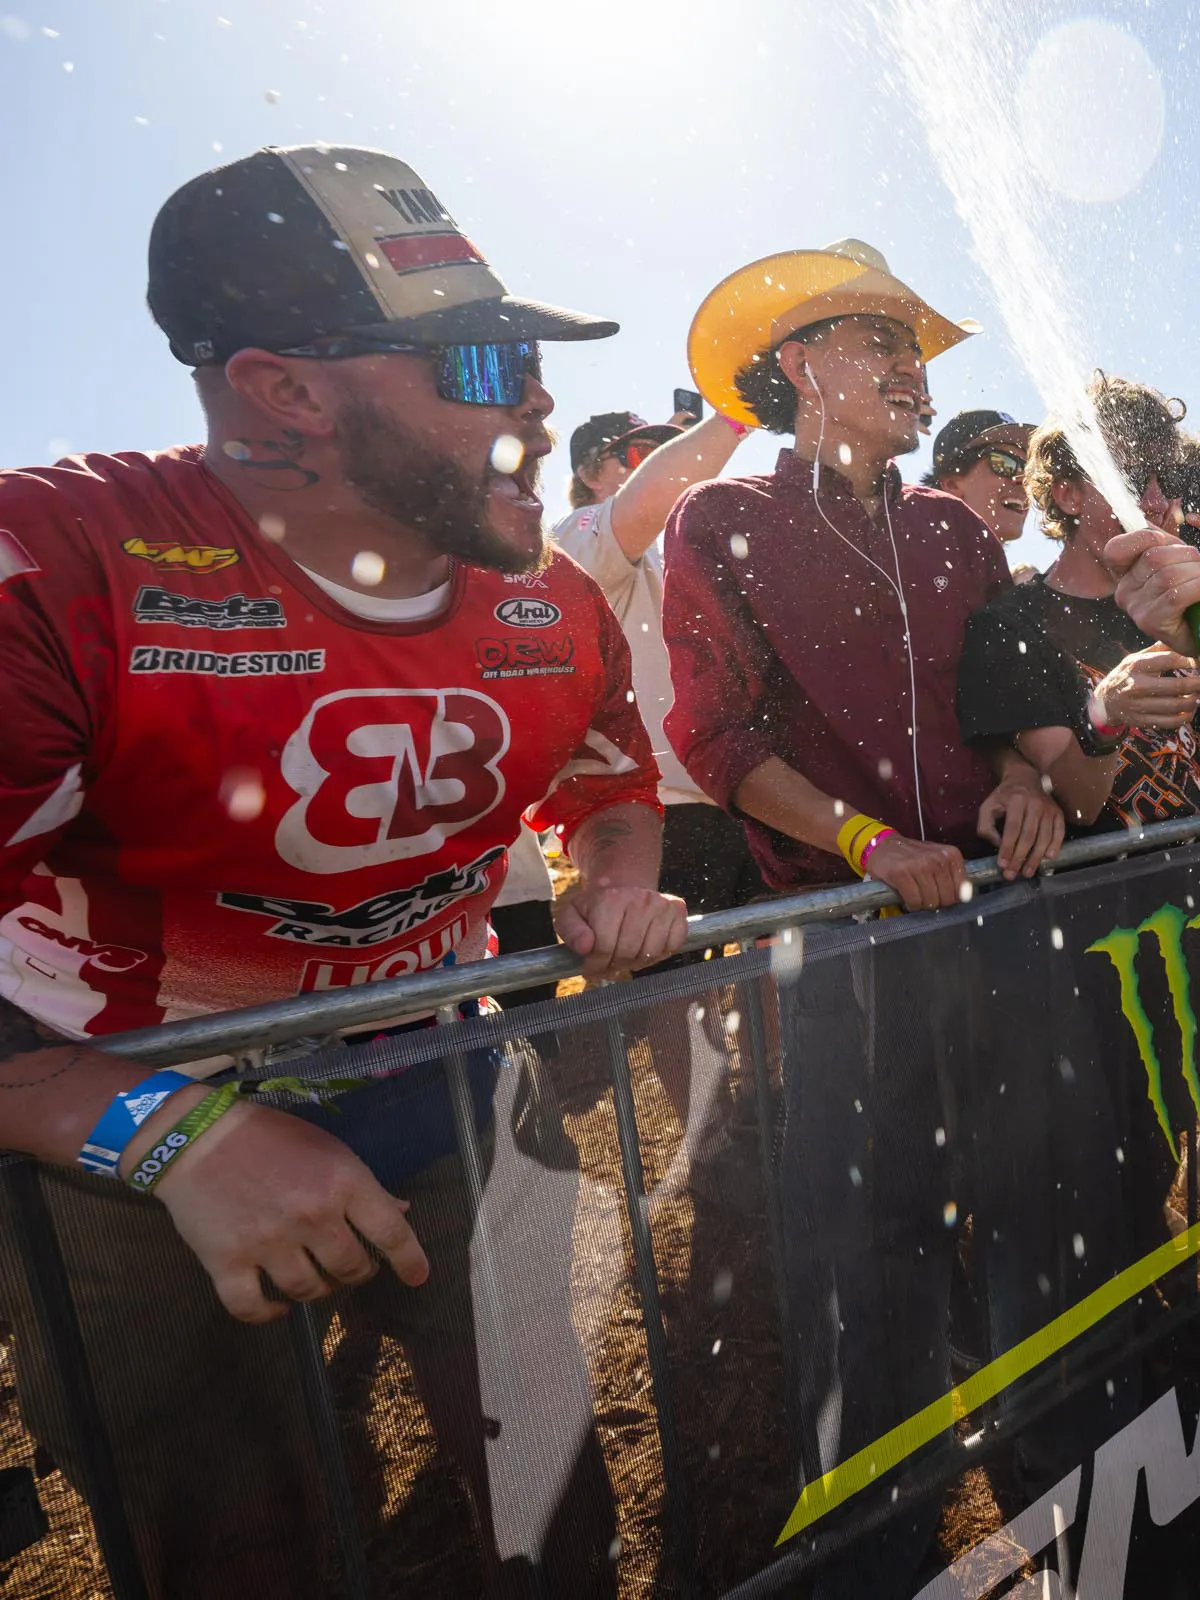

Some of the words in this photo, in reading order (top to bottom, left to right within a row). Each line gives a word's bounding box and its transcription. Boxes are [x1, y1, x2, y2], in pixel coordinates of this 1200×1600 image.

[504, 599, 552, 620] Arai
[130, 647, 323, 675] BRIDGESTONE
[272, 893, 459, 946] RACING
[133, 1131, 189, 1186] 2026
